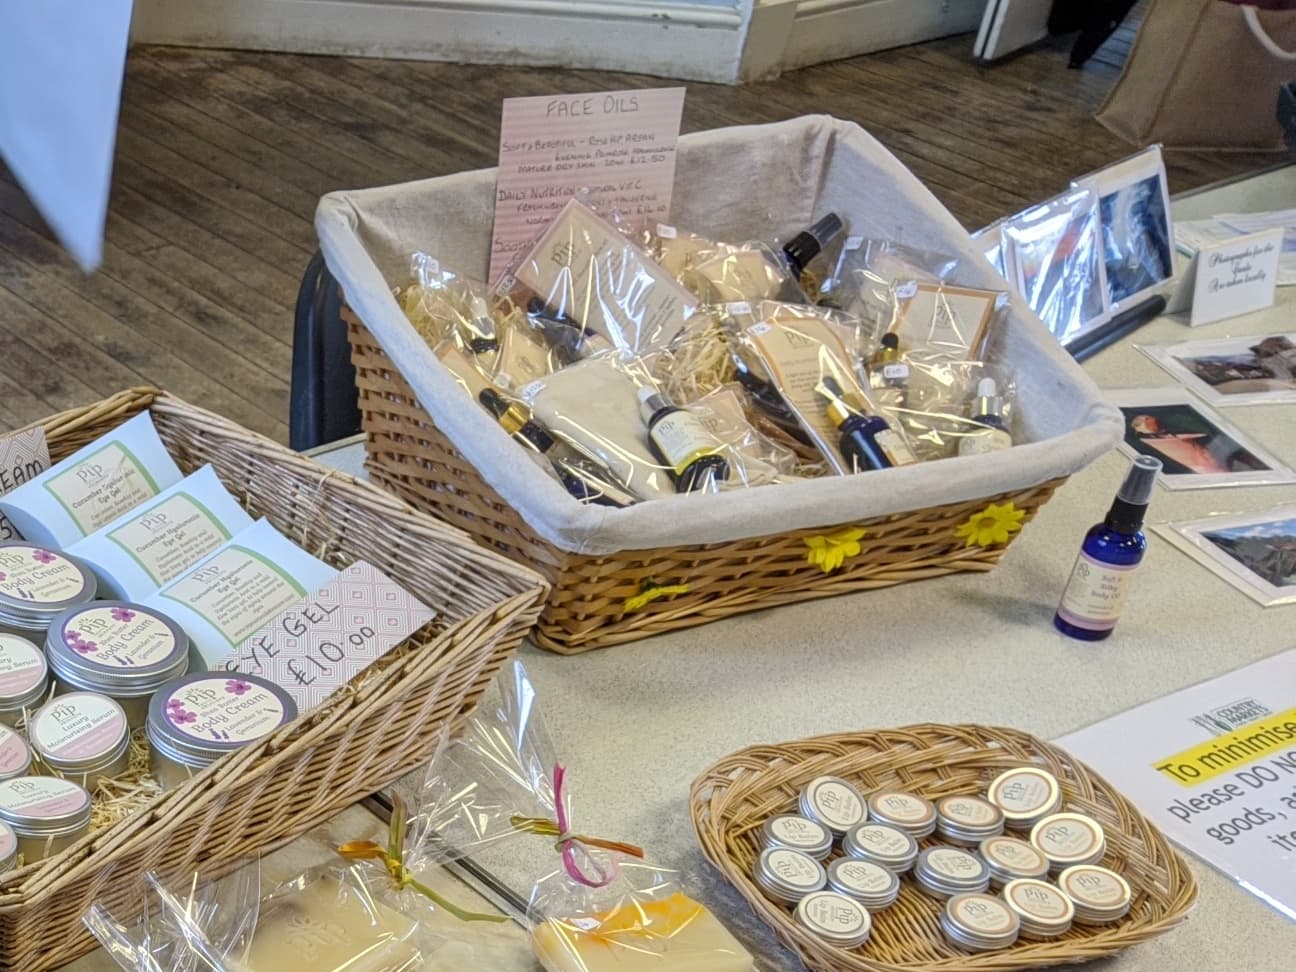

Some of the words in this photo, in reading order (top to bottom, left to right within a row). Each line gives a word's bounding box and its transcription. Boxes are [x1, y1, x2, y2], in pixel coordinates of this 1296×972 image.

[546, 98, 594, 117] FACE
[603, 96, 639, 114] OILS
[1, 576, 34, 591] Body
[31, 564, 70, 580] Cream
[96, 640, 128, 661] Body
[121, 619, 154, 641] Cream
[282, 602, 339, 638] GEL
[192, 713, 227, 733] Body
[225, 692, 268, 715] Cream
[1156, 763, 1201, 782] To
[1197, 722, 1296, 770] minimise
[1166, 783, 1245, 824] please
[1234, 765, 1279, 789] DO
